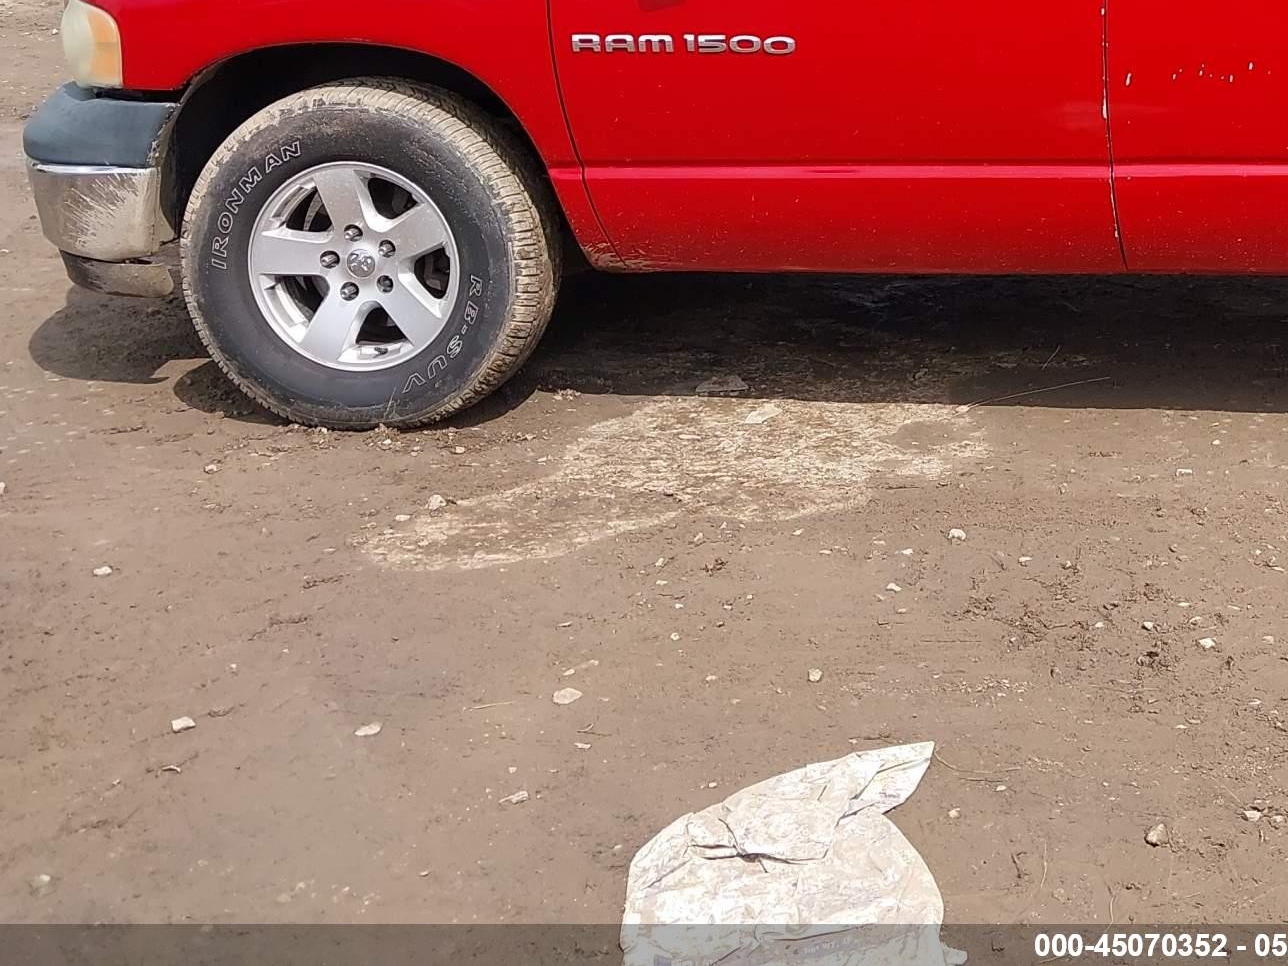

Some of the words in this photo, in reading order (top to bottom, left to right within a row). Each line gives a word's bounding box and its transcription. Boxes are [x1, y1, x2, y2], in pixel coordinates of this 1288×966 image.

[572, 34, 673, 52] RAM
[683, 34, 796, 54] 1500
[212, 140, 301, 270] IRONMAN
[402, 274, 483, 393] RB-SUV
